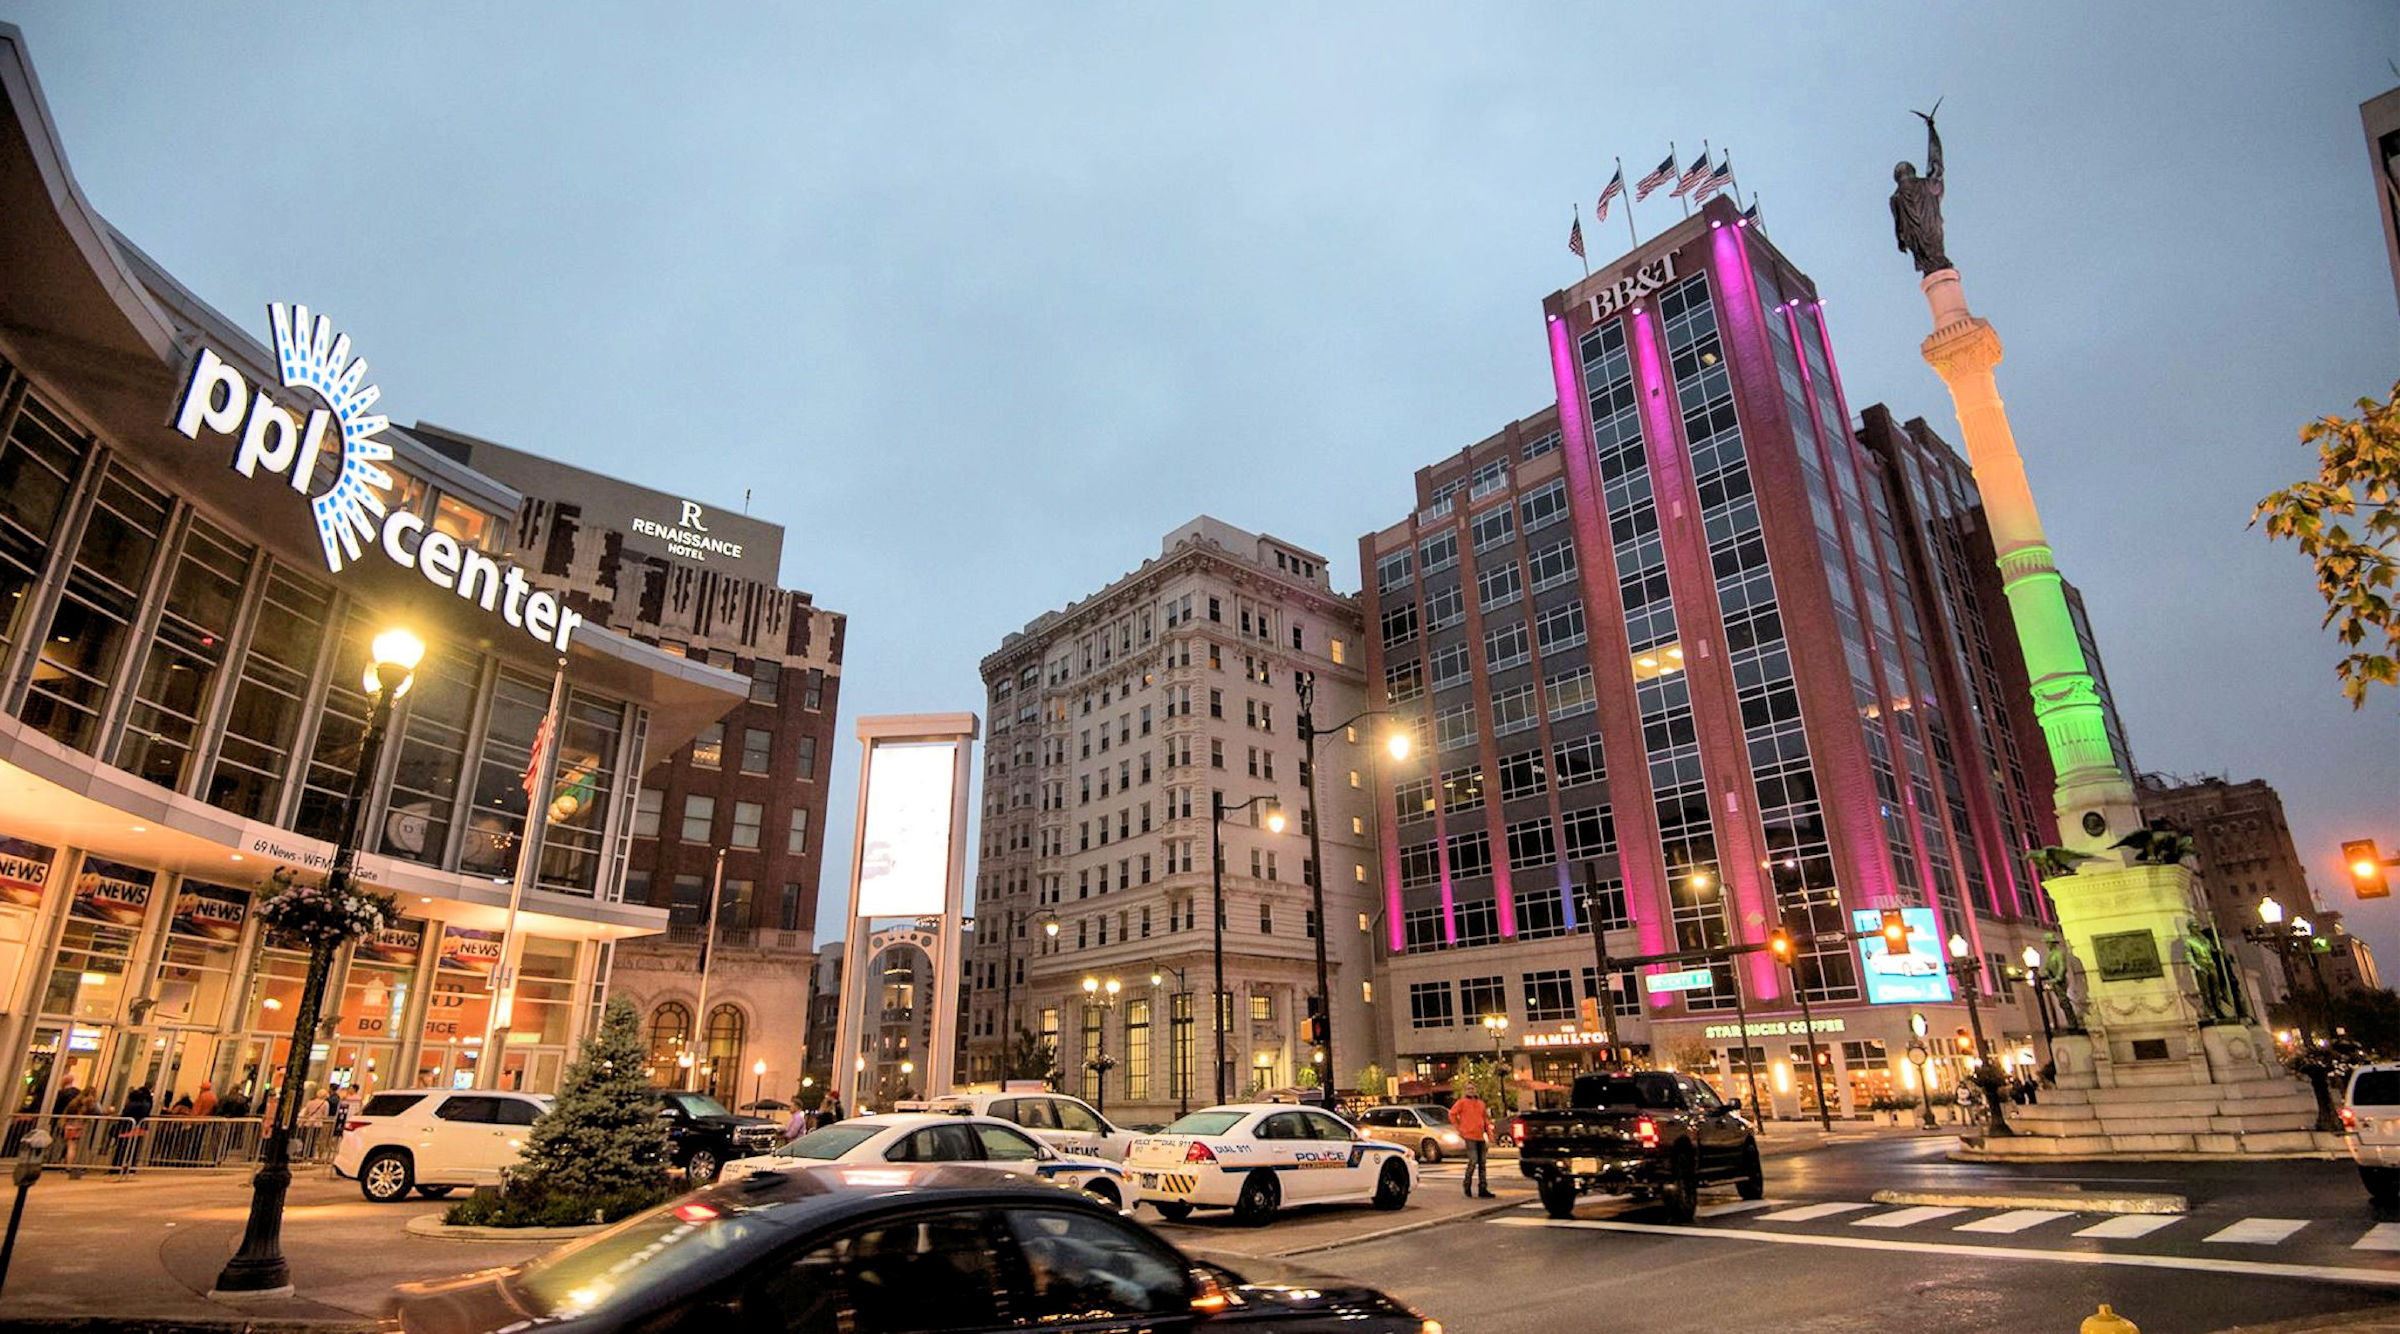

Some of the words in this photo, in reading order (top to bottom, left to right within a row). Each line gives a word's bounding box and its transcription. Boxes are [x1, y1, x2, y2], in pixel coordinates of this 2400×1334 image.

[1588, 247, 1682, 324] BB&T
[176, 346, 332, 495] ppl
[678, 499, 709, 532] R
[631, 517, 743, 559] RENAISSANCE
[667, 542, 706, 562] HOTEL
[381, 510, 582, 653] center
[253, 839, 268, 852] 69
[269, 843, 296, 861] News
[97, 879, 147, 904] NEWS
[196, 900, 242, 921] NEWS
[376, 930, 418, 947] NEWS
[460, 942, 499, 957] NEWS
[1788, 1019, 1845, 1034] COFFEE
[1295, 1151, 1346, 1162] POLICE
